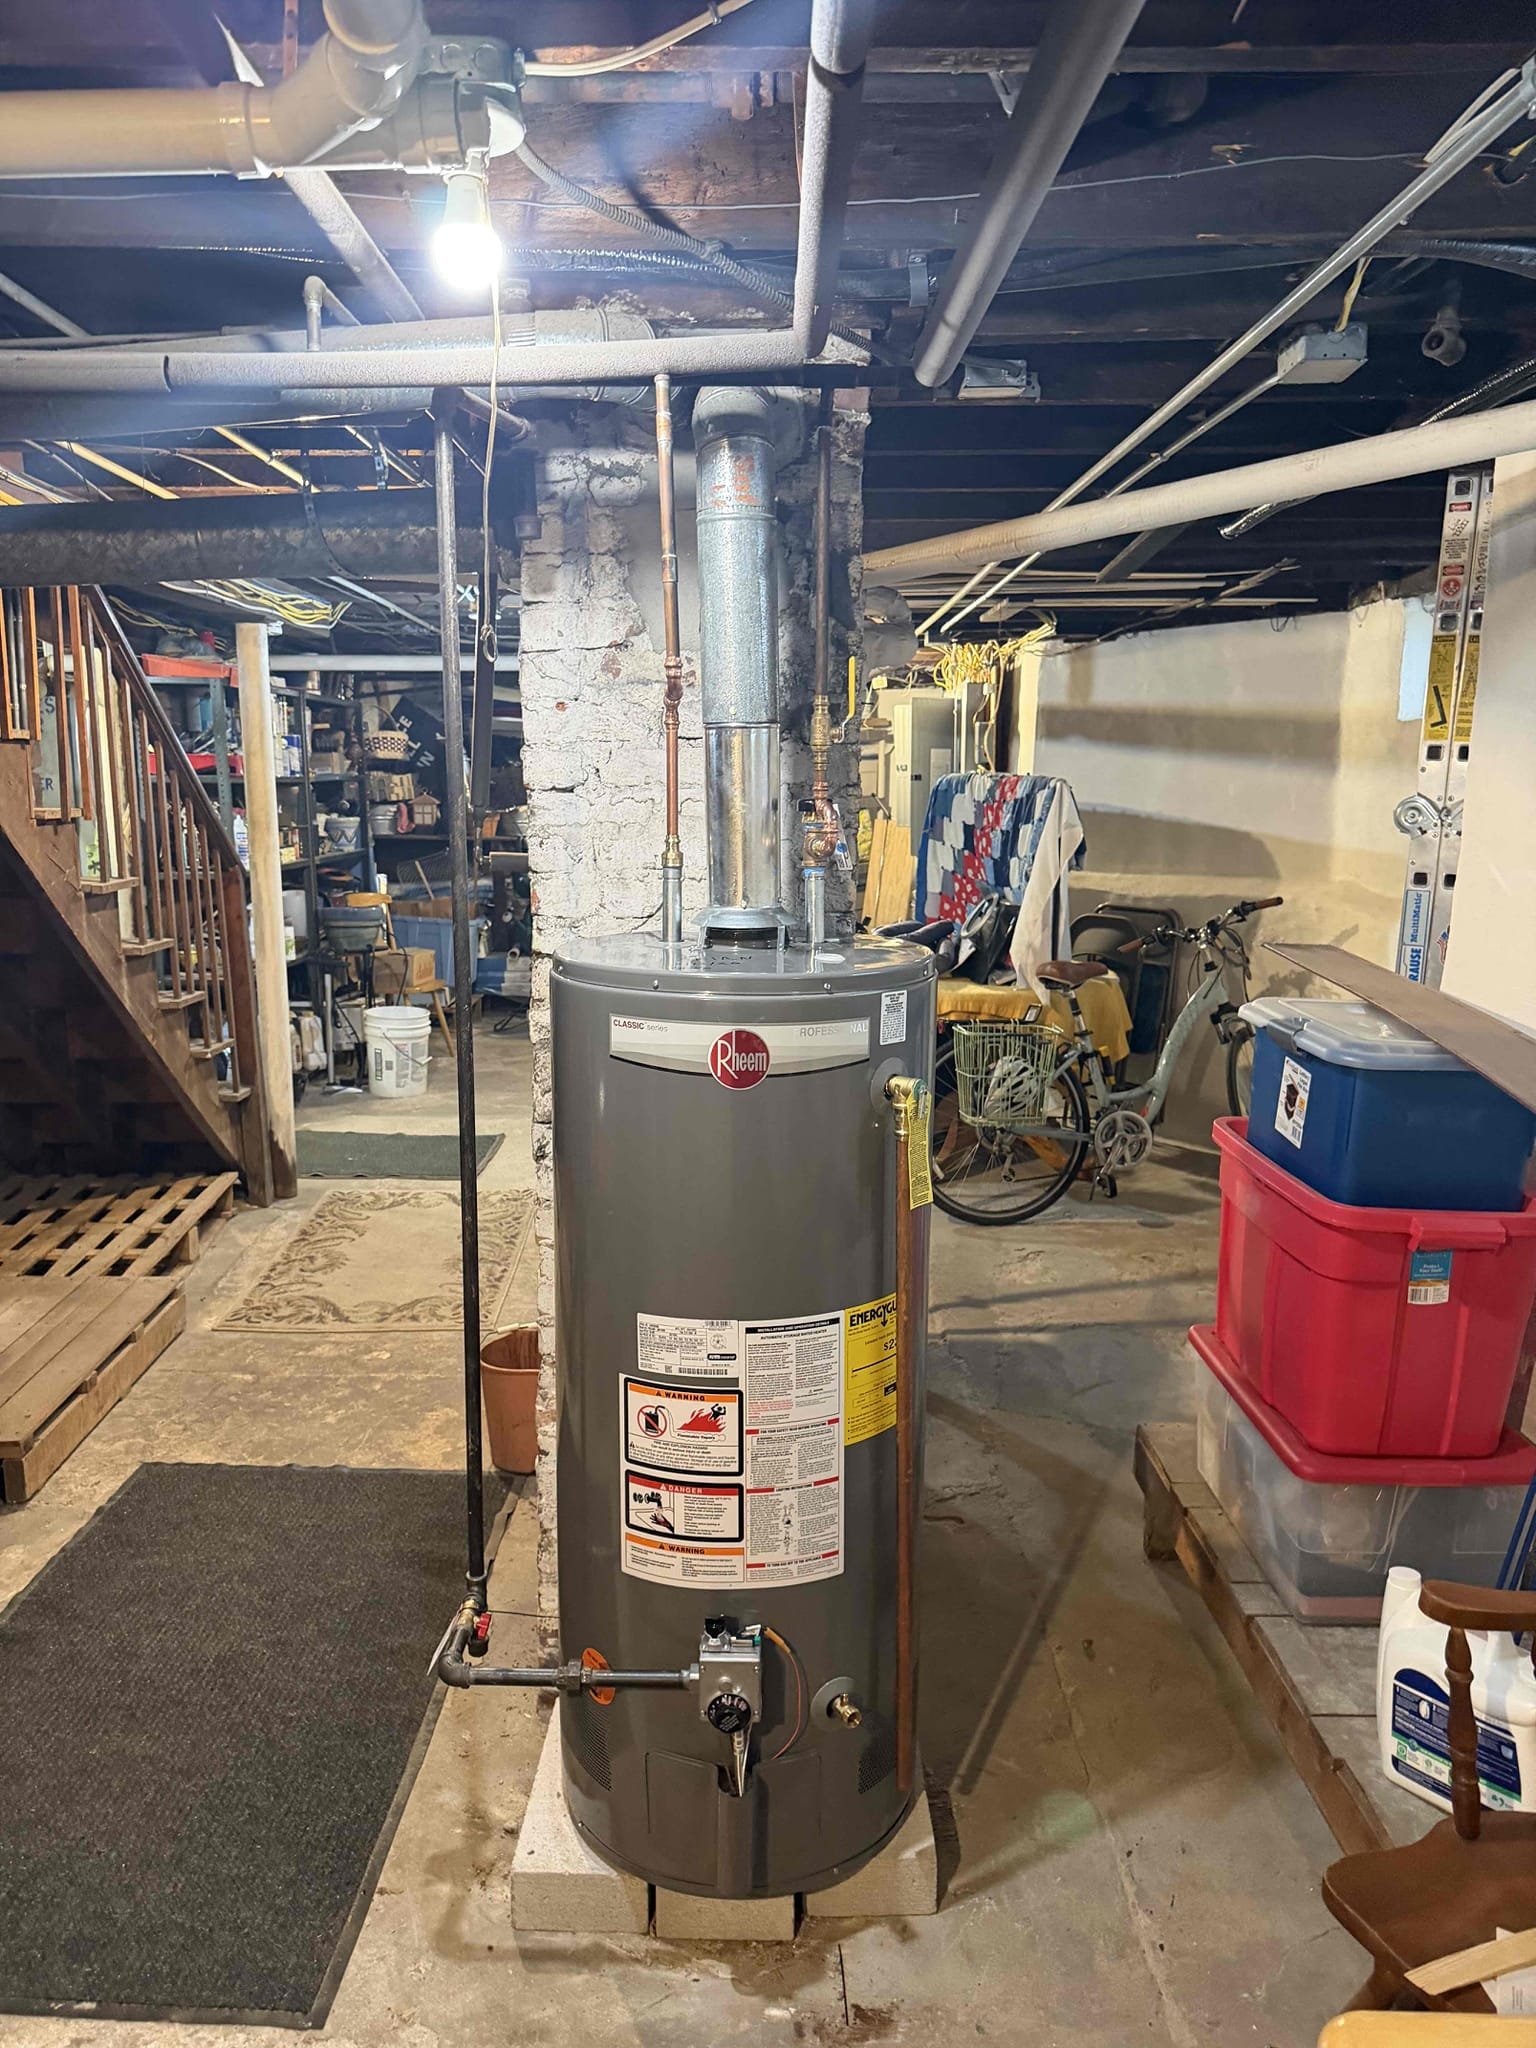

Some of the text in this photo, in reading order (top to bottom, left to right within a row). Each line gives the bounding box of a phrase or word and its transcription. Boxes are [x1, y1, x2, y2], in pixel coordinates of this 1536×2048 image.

[613, 1019, 669, 1033] CLASSIC series
[717, 1029, 769, 1080] Rheem
[665, 1391, 705, 1402] WARNING
[669, 1484, 703, 1494] DANGER
[668, 1545, 706, 1555] WARNING
